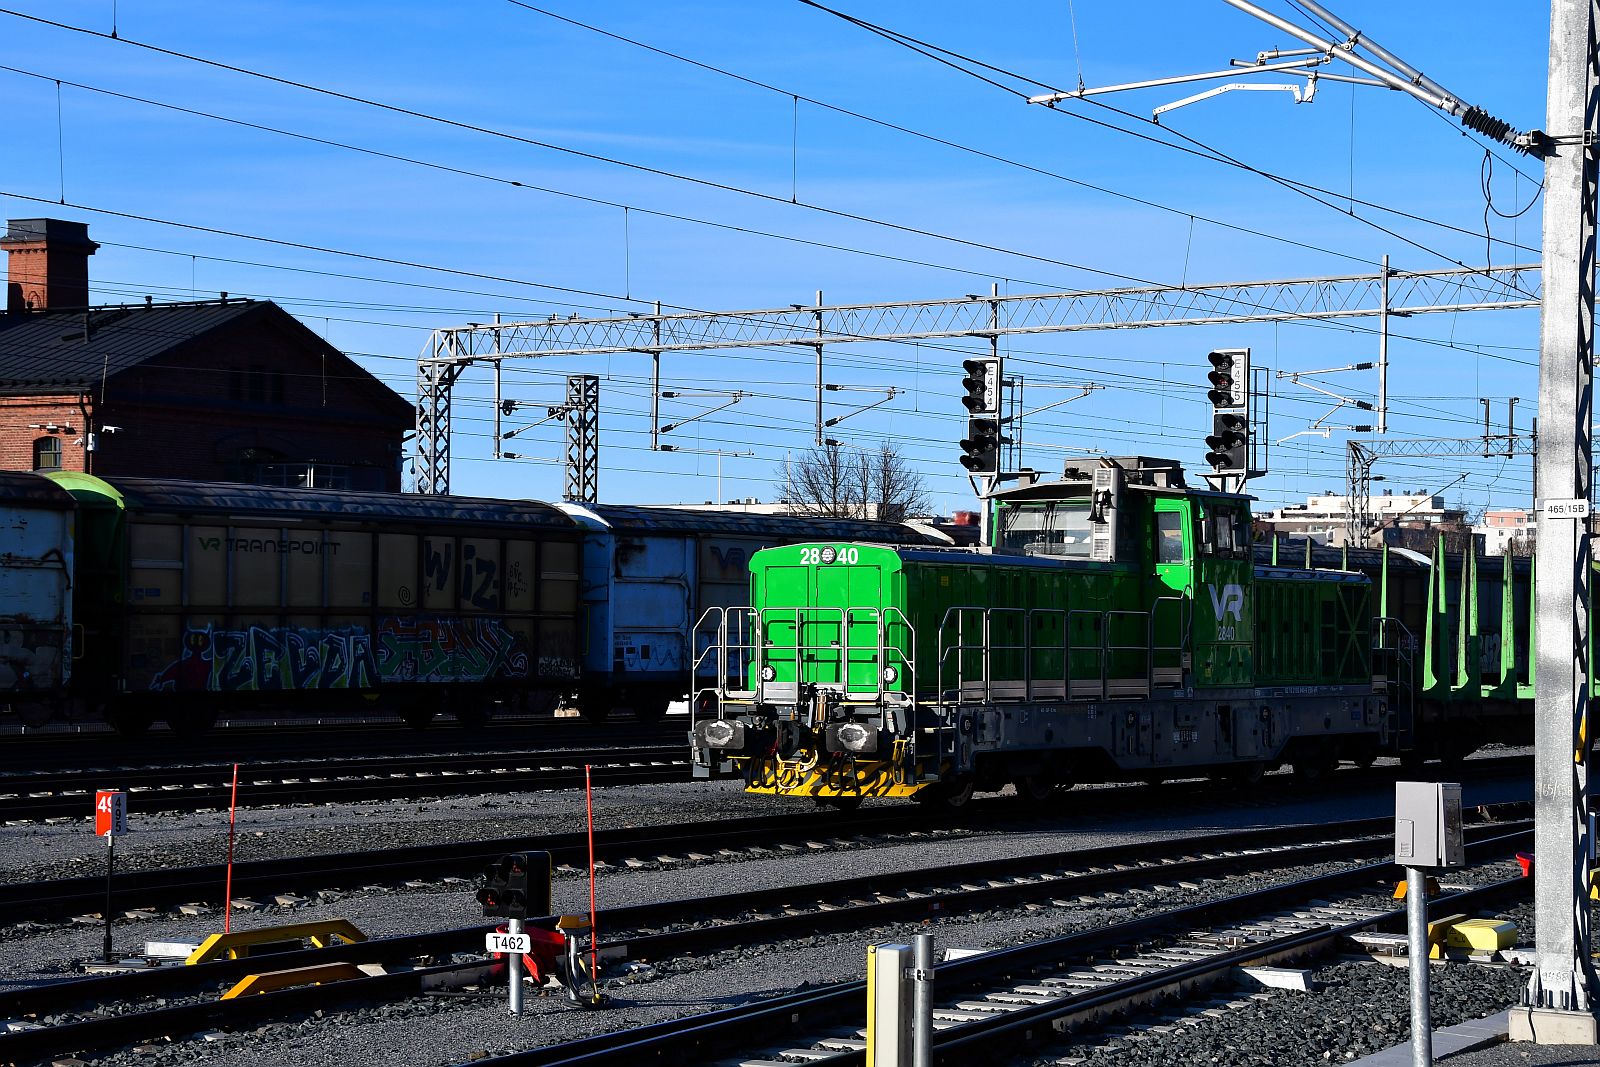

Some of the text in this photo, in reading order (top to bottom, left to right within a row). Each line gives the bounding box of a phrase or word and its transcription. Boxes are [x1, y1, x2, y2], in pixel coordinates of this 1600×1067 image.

[1234, 358, 1242, 401] E455
[1548, 502, 1585, 515] 465/15B
[199, 537, 220, 550] VR
[800, 547, 859, 565] 28 40
[1207, 583, 1243, 621] VR
[1218, 625, 1235, 641] 2840
[114, 796, 122, 833] 495
[492, 935, 524, 951] T462
